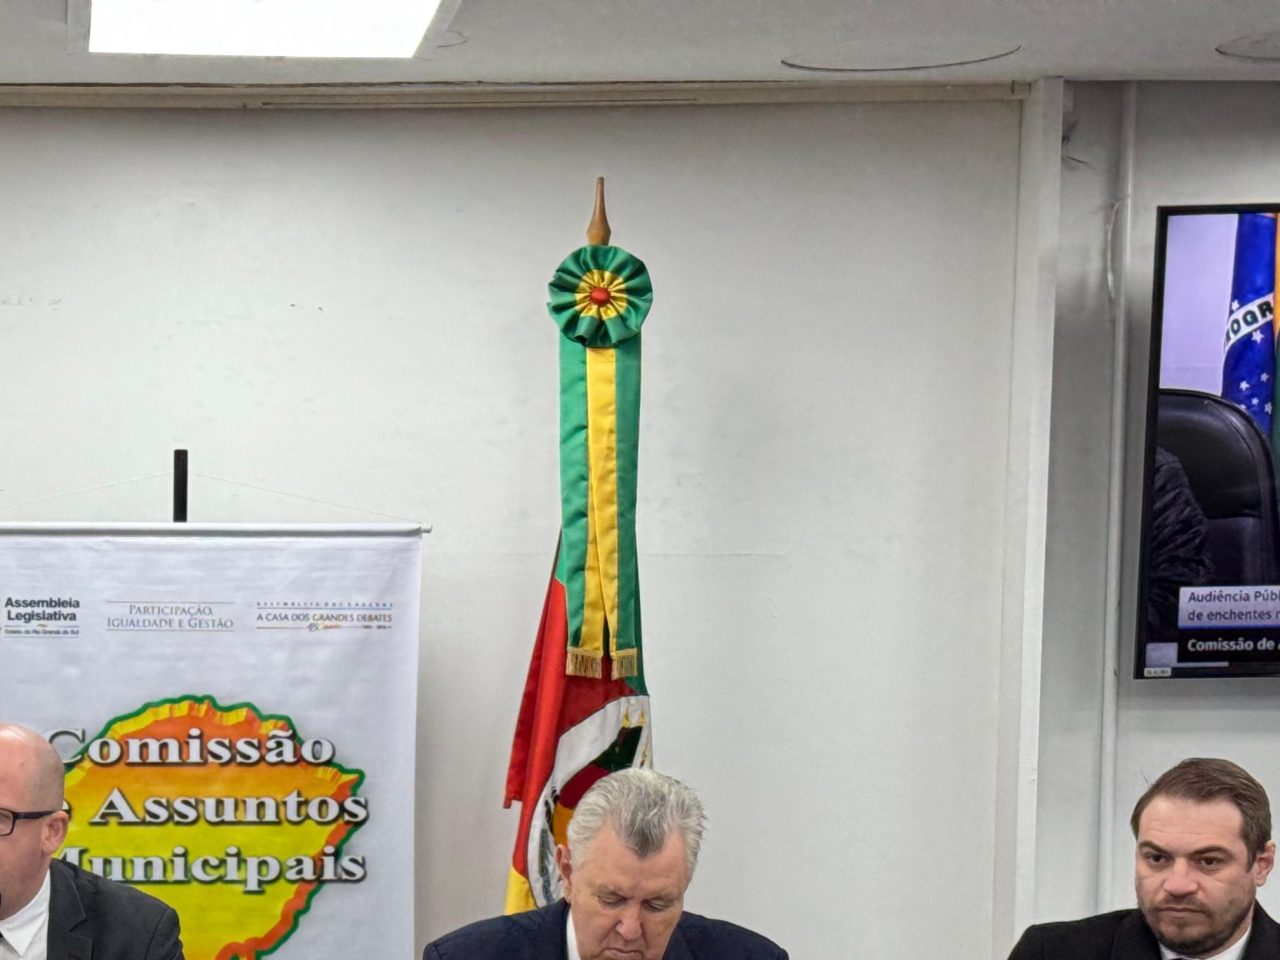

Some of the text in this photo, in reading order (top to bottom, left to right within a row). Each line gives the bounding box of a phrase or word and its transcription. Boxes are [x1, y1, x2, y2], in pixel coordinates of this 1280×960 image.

[1188, 590, 1250, 602] Audiência
[4, 597, 80, 608] Assembleia
[7, 610, 77, 623] Legislativa
[257, 613, 393, 622] A CASA DOS GRANDES DEBATES
[1188, 610, 1203, 620] de
[1207, 609, 1272, 620] enchentes
[1187, 637, 1254, 651] Comissão
[1257, 637, 1275, 650] de
[88, 786, 370, 826] Assuntos
